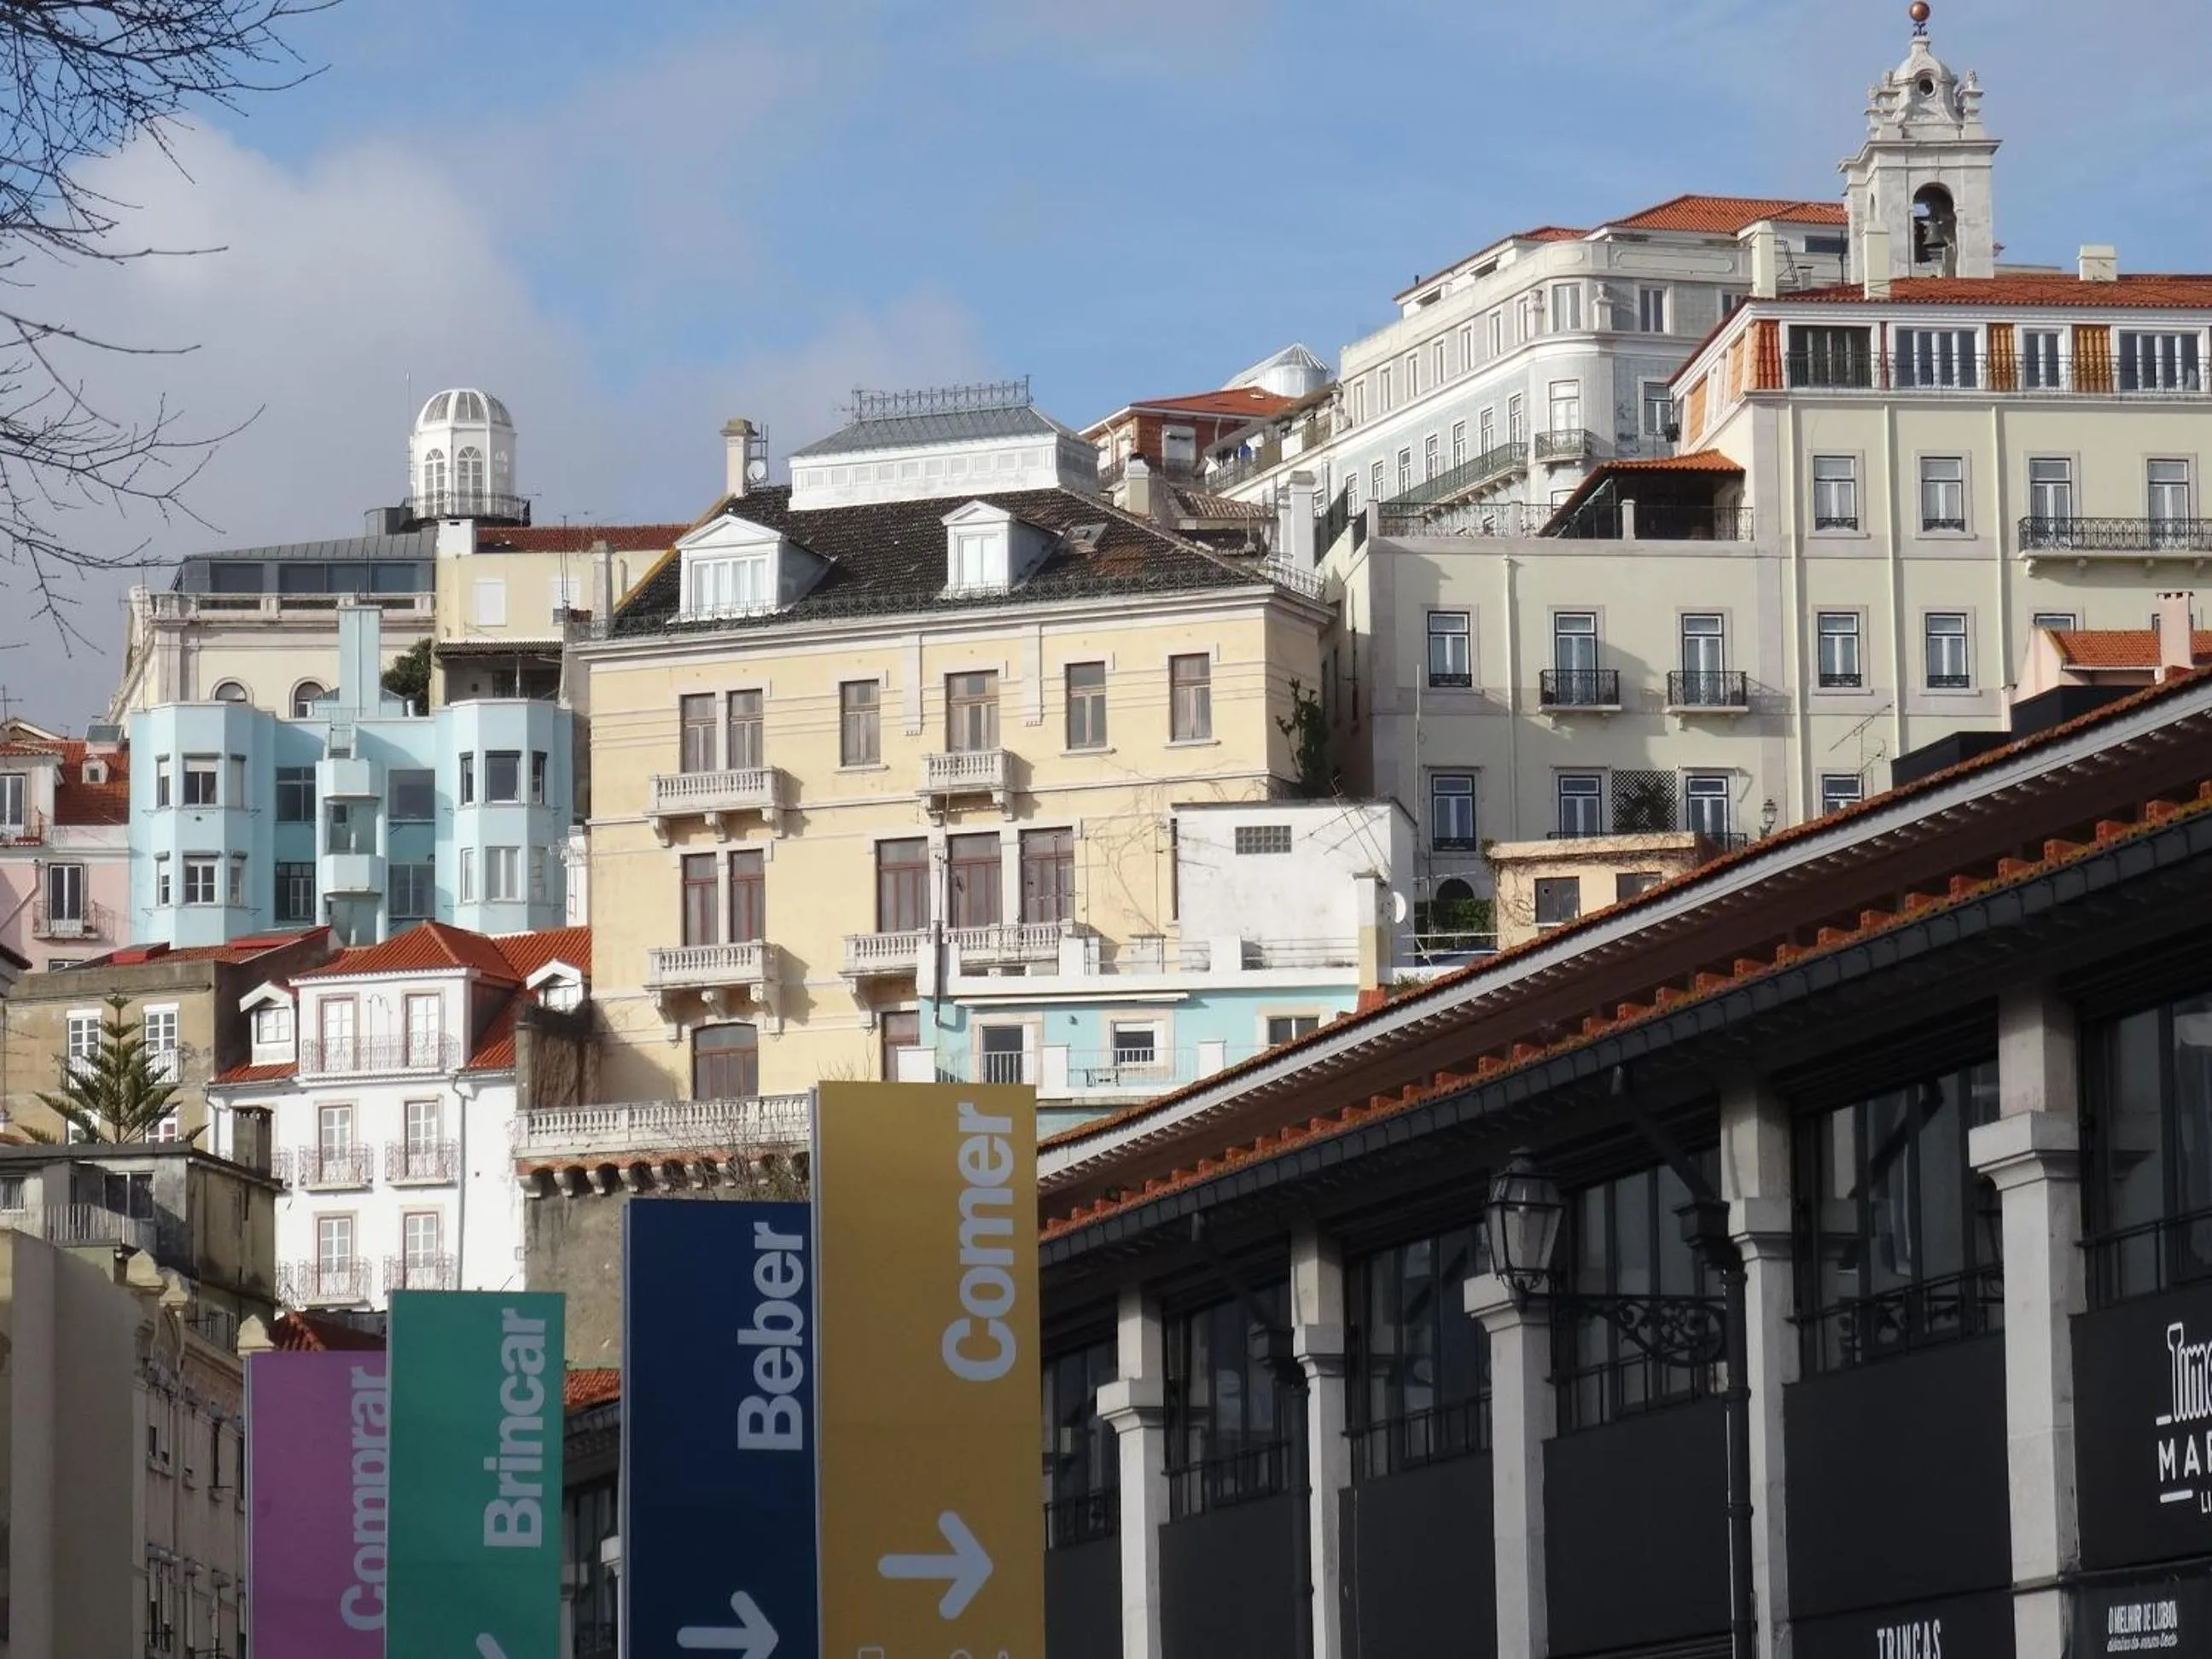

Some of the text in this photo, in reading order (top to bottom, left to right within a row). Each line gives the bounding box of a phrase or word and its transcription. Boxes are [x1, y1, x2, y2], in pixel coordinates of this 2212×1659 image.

[736, 1221, 804, 1451] Beber
[941, 1102, 1016, 1382] Comer
[341, 1365, 386, 1632] Comprar
[482, 1307, 546, 1548] Brincar
[1877, 1618, 1941, 1659] TRINCAS
